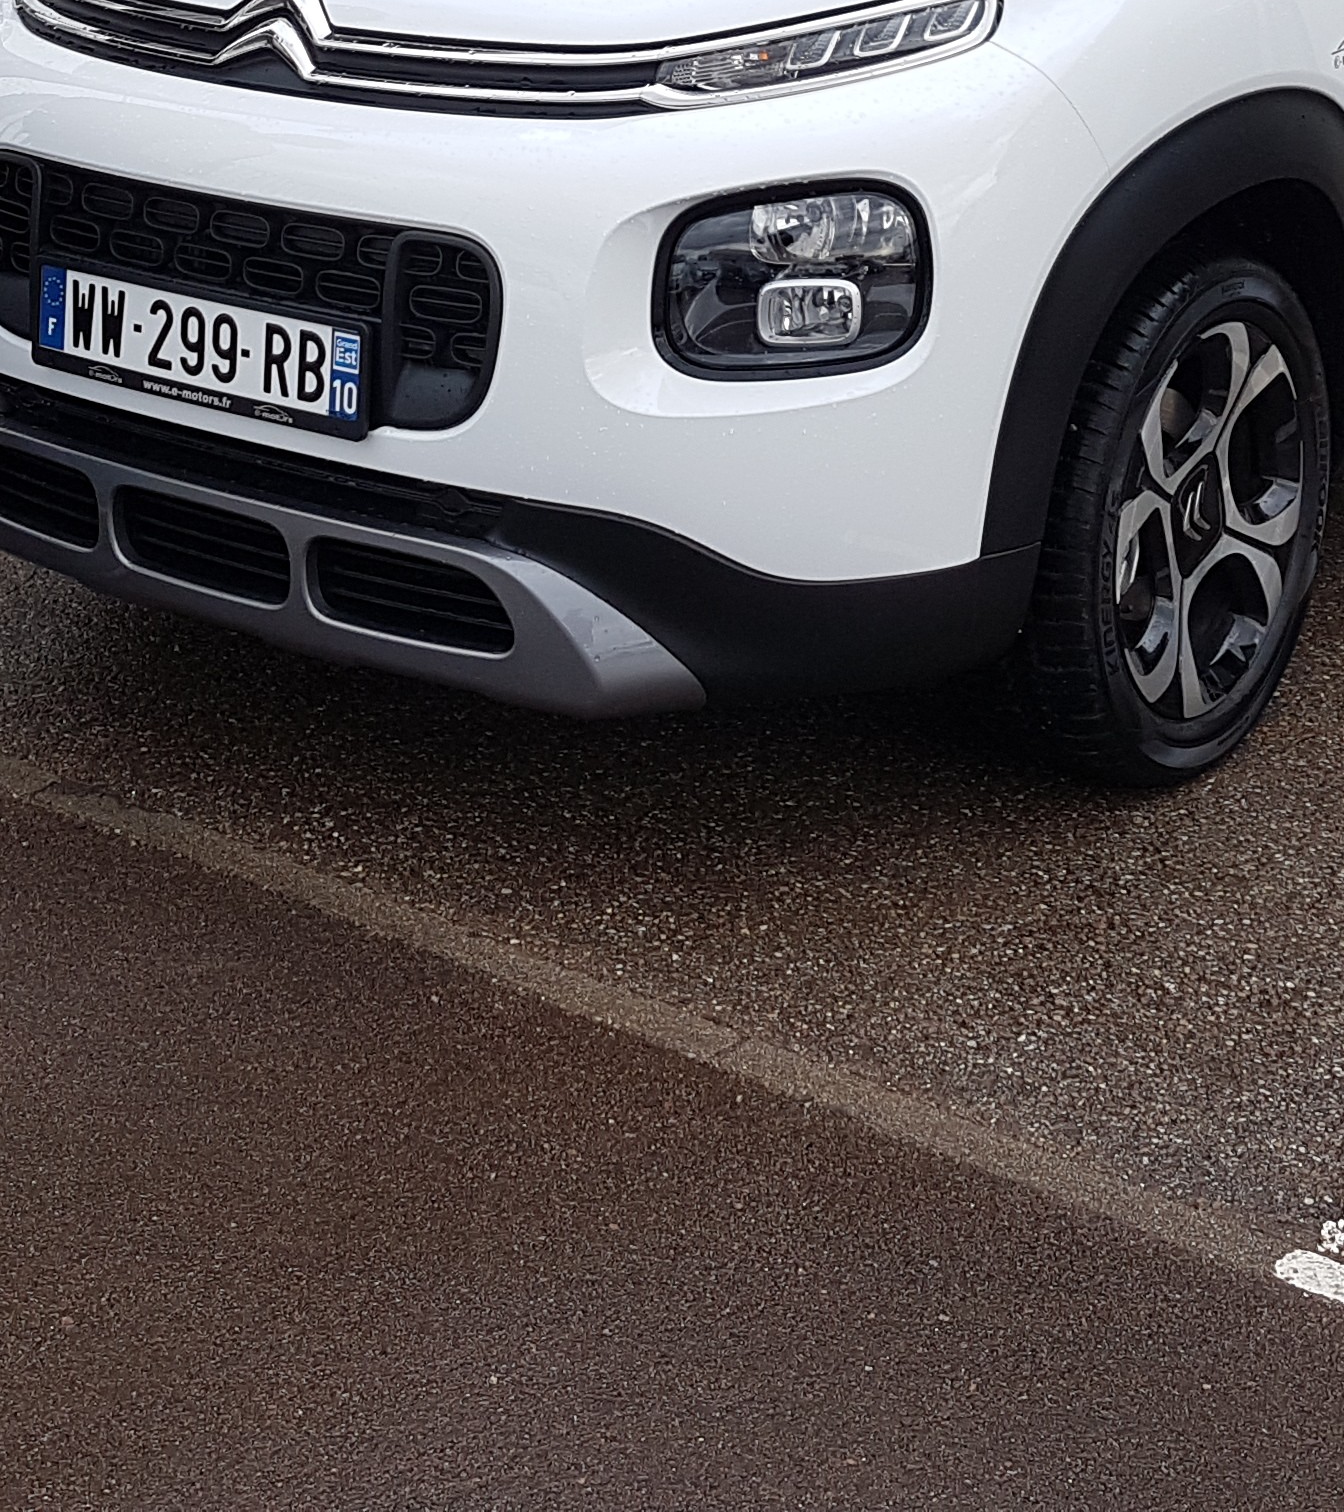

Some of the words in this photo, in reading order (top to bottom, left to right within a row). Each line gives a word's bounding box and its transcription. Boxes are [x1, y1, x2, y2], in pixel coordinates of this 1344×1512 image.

[47, 317, 57, 336] F
[336, 346, 357, 366] Est
[142, 379, 232, 408] www.e-motors.fr
[332, 378, 358, 415] 10
